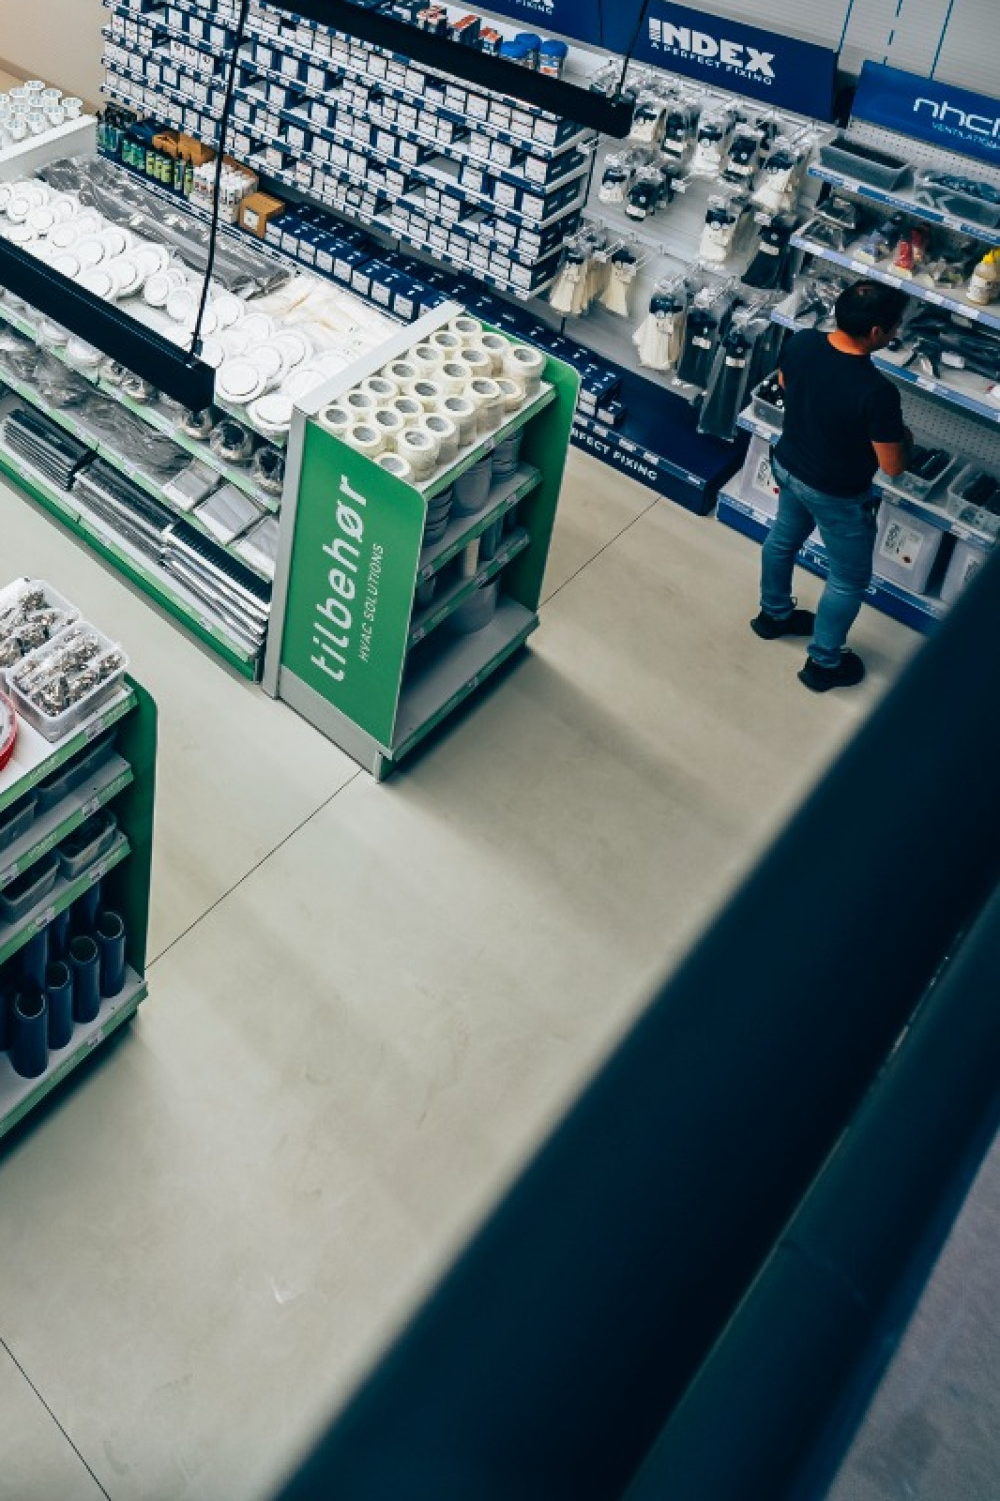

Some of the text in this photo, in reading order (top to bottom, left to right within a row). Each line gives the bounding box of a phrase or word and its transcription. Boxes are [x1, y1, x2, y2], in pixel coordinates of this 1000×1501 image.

[649, 17, 775, 78] INDEX
[310, 473, 368, 683] tilbehør
[357, 543, 385, 664] HVAC SOLUTIONS
